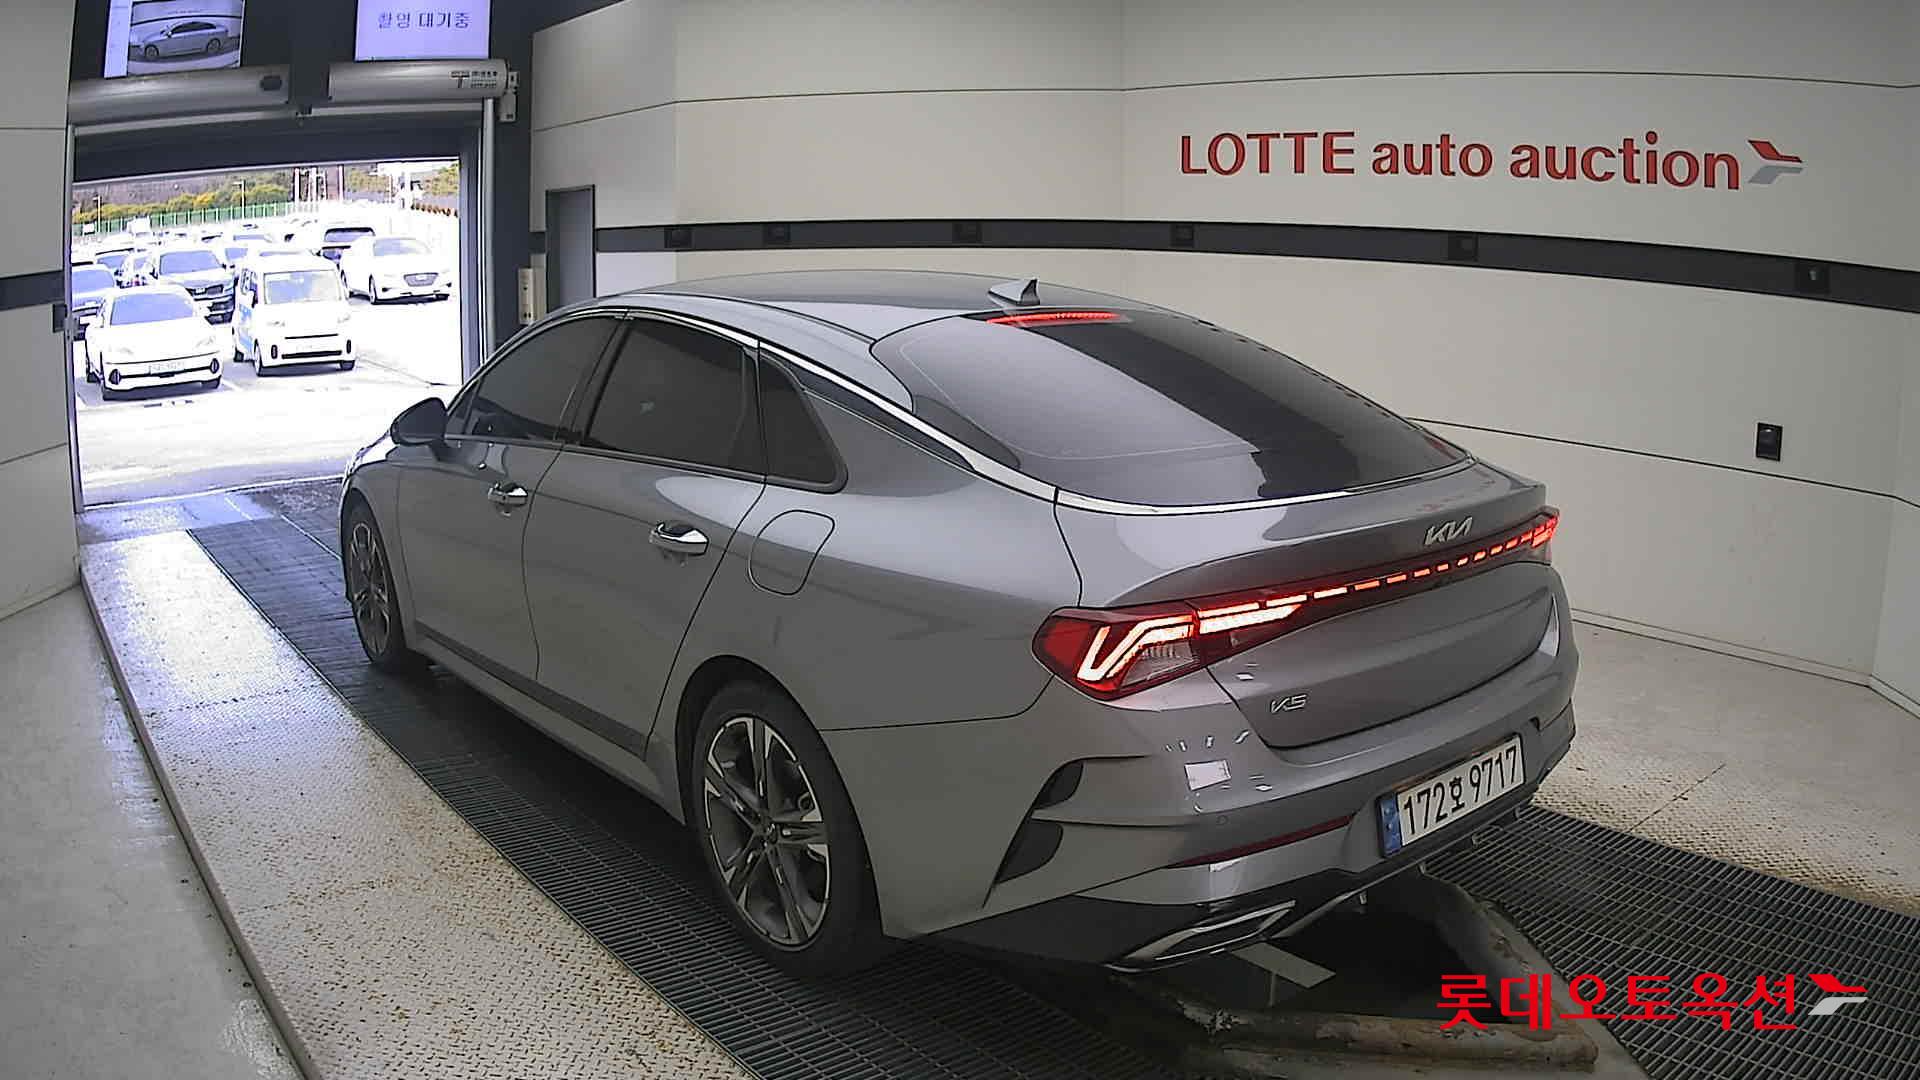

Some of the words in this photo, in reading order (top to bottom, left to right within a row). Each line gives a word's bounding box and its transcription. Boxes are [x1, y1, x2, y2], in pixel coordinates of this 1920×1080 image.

[419, 12, 469, 28] 대기중
[1180, 131, 1356, 176] LOTTE
[1371, 133, 1493, 178] auto
[1510, 131, 1740, 190] auction
[1271, 694, 1307, 713] K5
[1403, 777, 1465, 835] 172호
[1469, 745, 1517, 803] 9717
